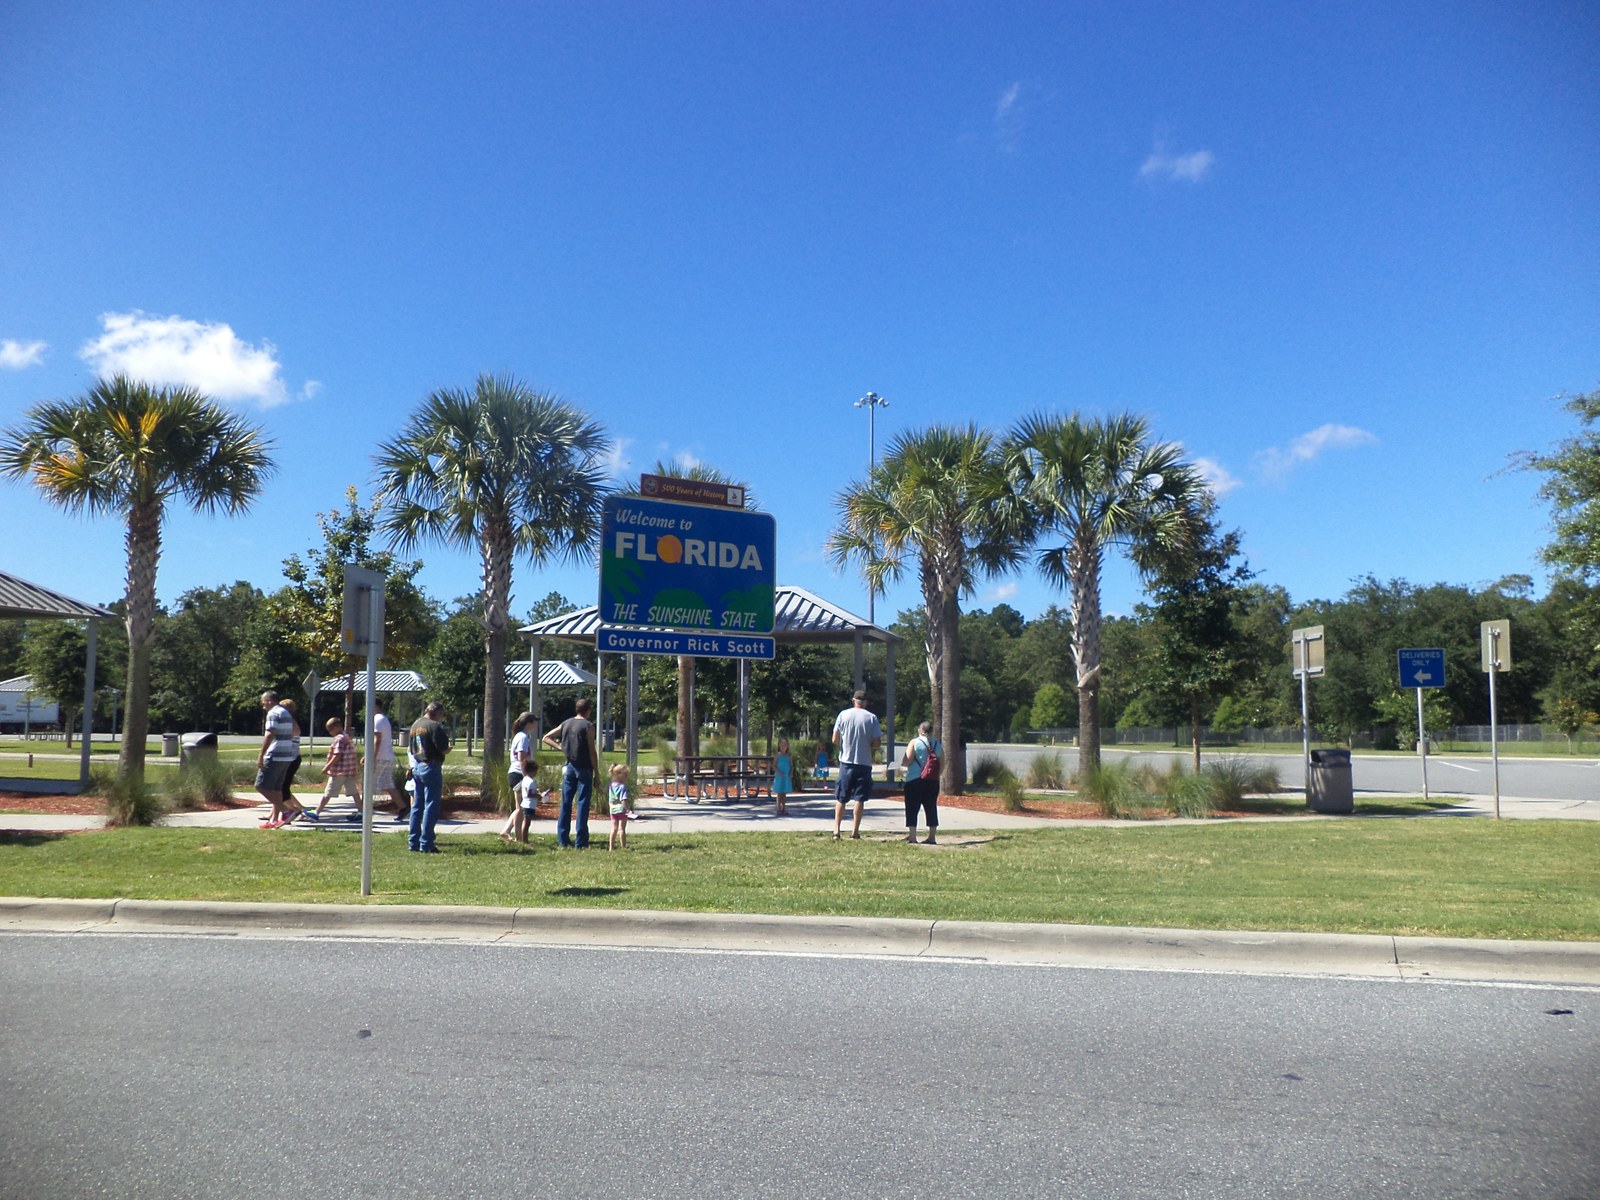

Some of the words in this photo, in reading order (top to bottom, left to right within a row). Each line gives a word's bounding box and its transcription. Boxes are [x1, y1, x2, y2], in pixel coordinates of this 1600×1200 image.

[661, 484, 675, 492] 500
[676, 485, 693, 495] Years
[695, 489, 702, 497] of
[703, 490, 725, 500] History
[616, 508, 675, 529] Welcome
[679, 518, 692, 531] to
[615, 532, 763, 571] FLORIDA
[613, 603, 638, 621] THE
[647, 606, 712, 625] SUNSHINE
[721, 611, 757, 628] STATE
[608, 634, 679, 650] Governor
[688, 638, 719, 652] Rick
[728, 640, 765, 654] Scott
[1401, 651, 1440, 659] DELIVERIES
